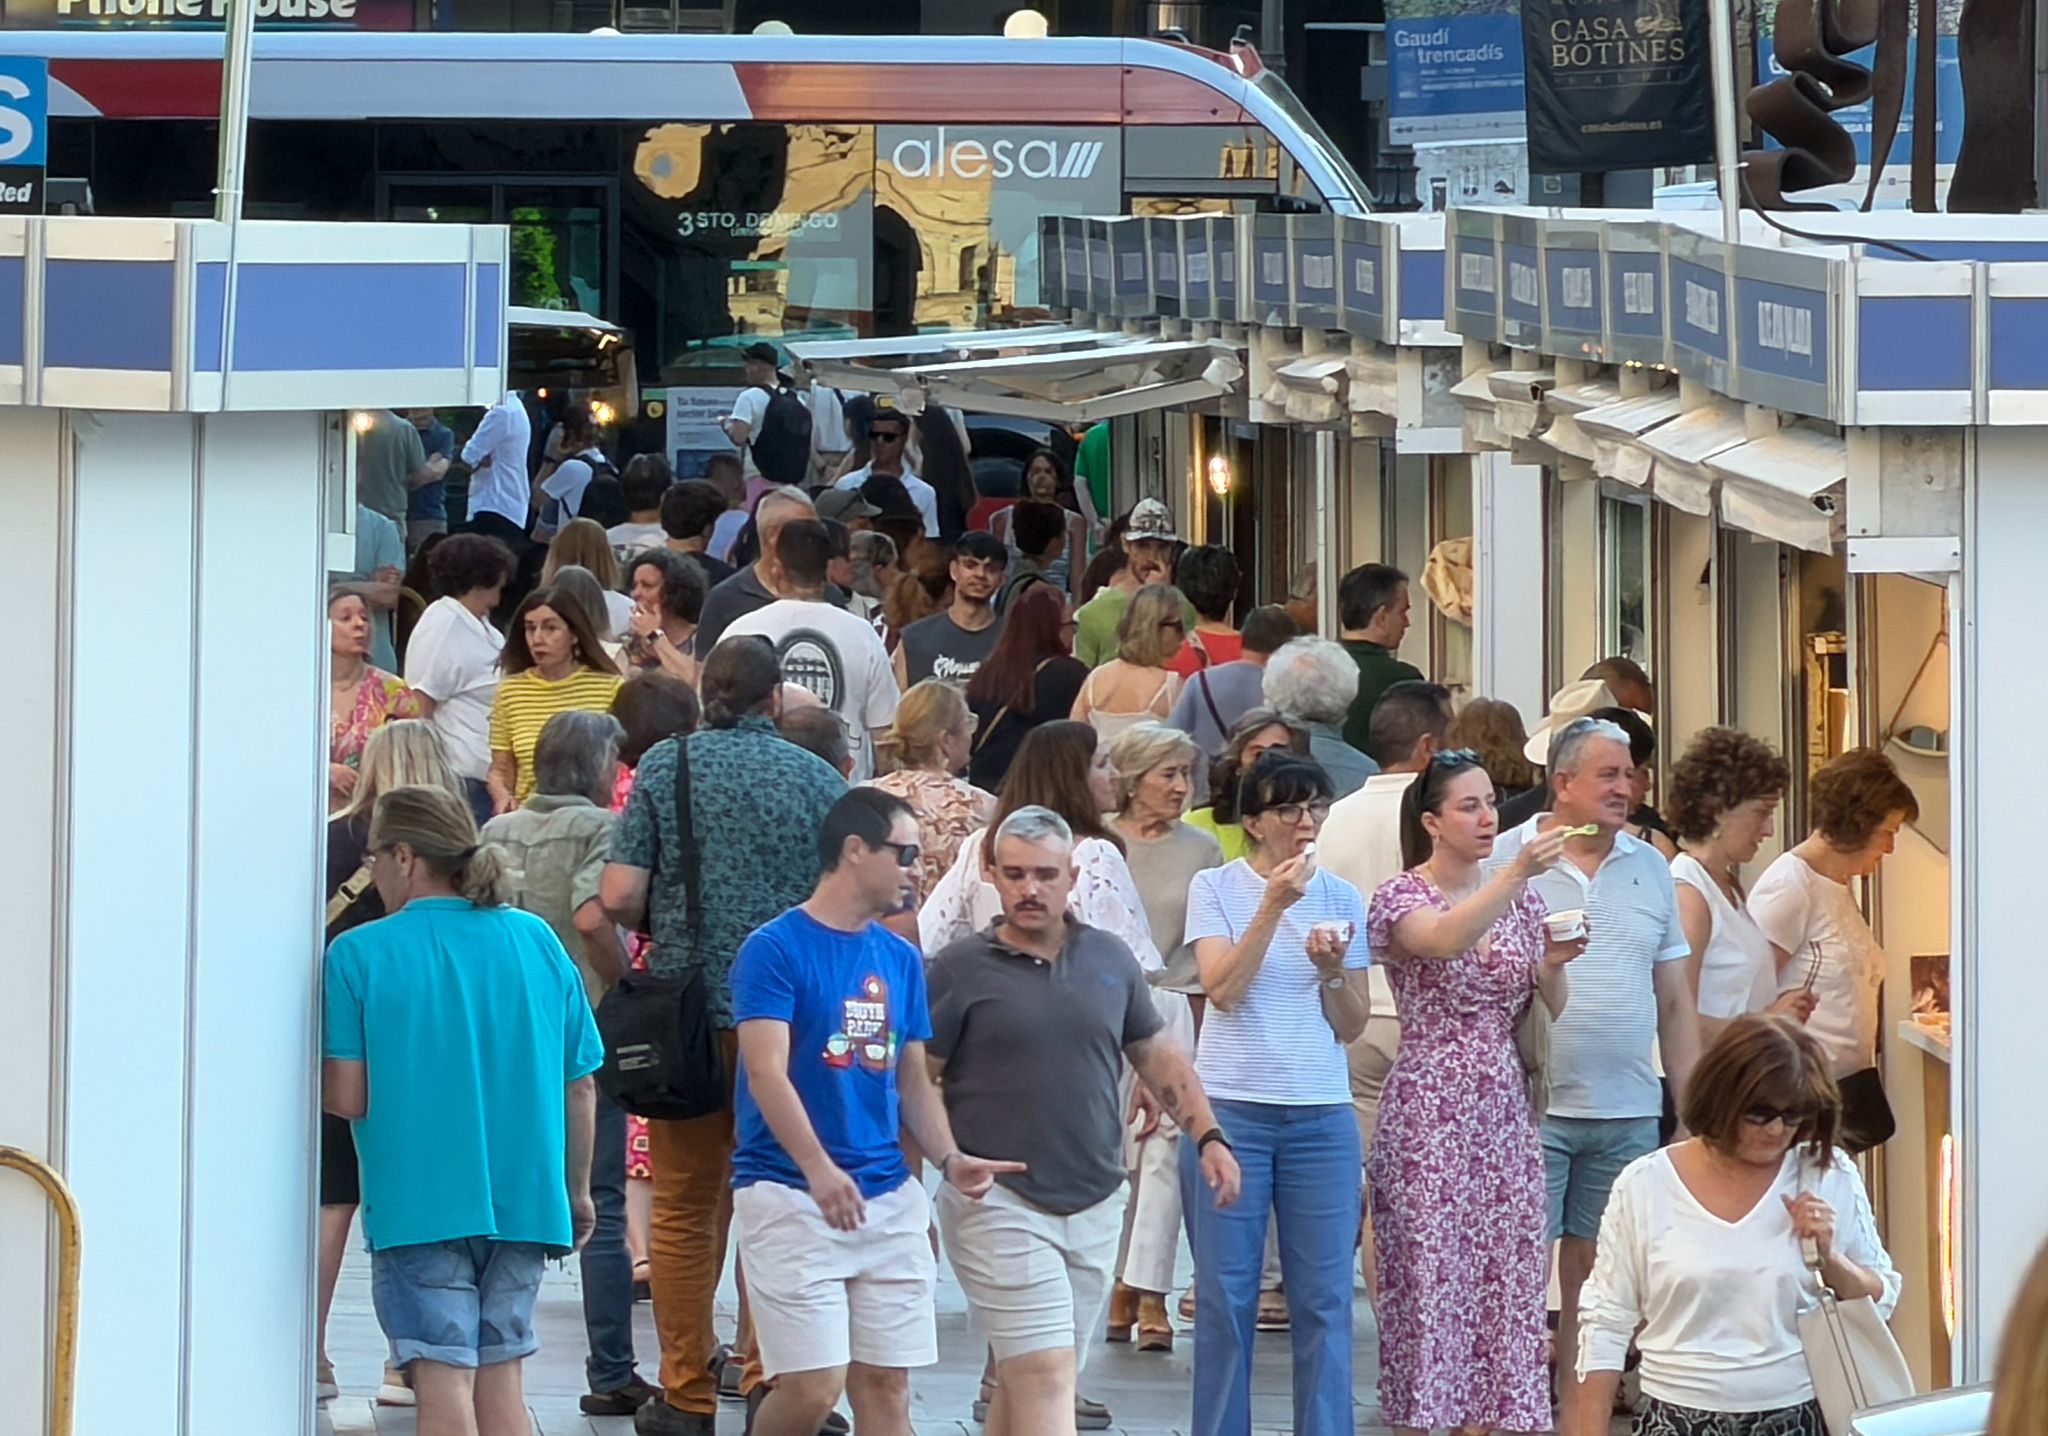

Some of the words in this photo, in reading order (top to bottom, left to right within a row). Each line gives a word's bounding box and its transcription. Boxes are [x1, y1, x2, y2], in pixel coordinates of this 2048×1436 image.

[211, 0, 356, 18] ouse
[1394, 27, 1450, 47] Gaudí
[1551, 16, 1630, 42] CASA
[1417, 44, 1505, 64] trencadís
[1552, 38, 1686, 67] BOTINES
[892, 126, 1057, 179] alesa
[677, 212, 694, 237] 3
[696, 212, 740, 229] STO.
[746, 212, 838, 229] DOGO
